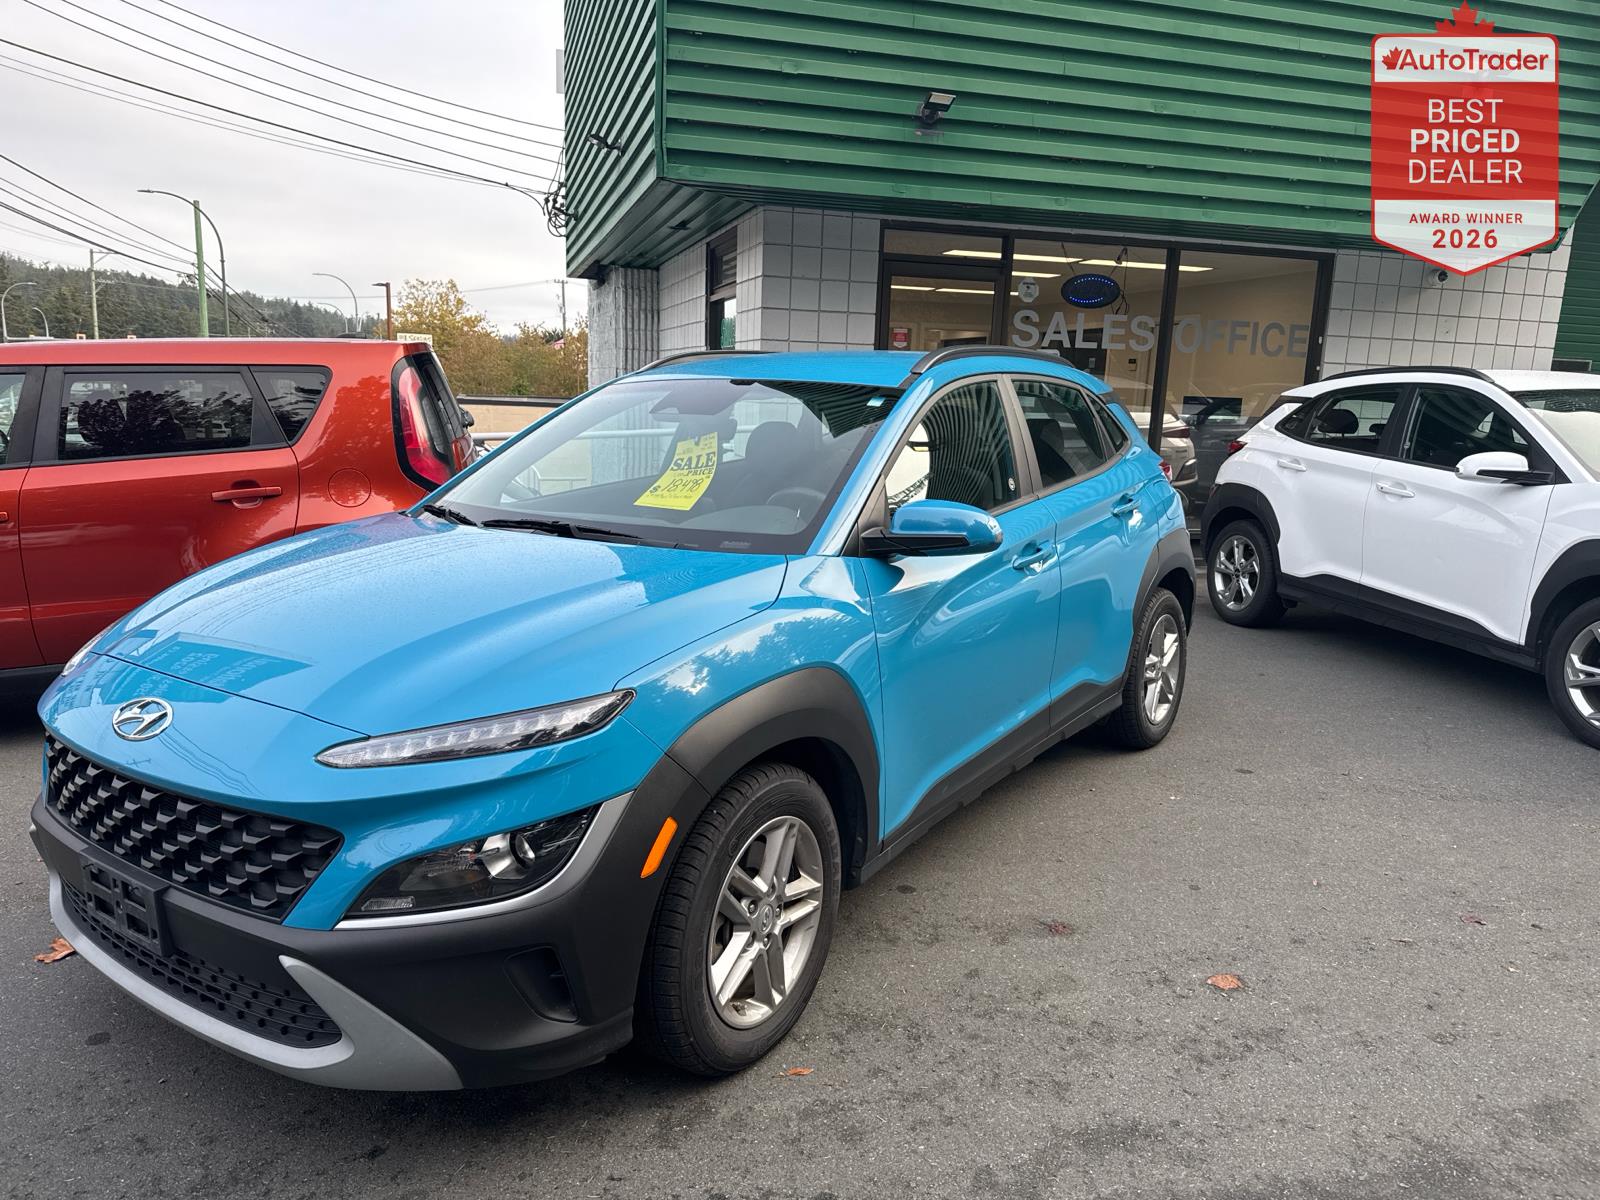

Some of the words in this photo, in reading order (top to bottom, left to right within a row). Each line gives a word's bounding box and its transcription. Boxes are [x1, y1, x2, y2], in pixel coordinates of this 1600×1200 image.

[1011, 309, 1155, 351] SALES
[1174, 317, 1310, 359] OFFICE
[670, 451, 716, 471] SALE
[687, 467, 714, 476] PRICE
